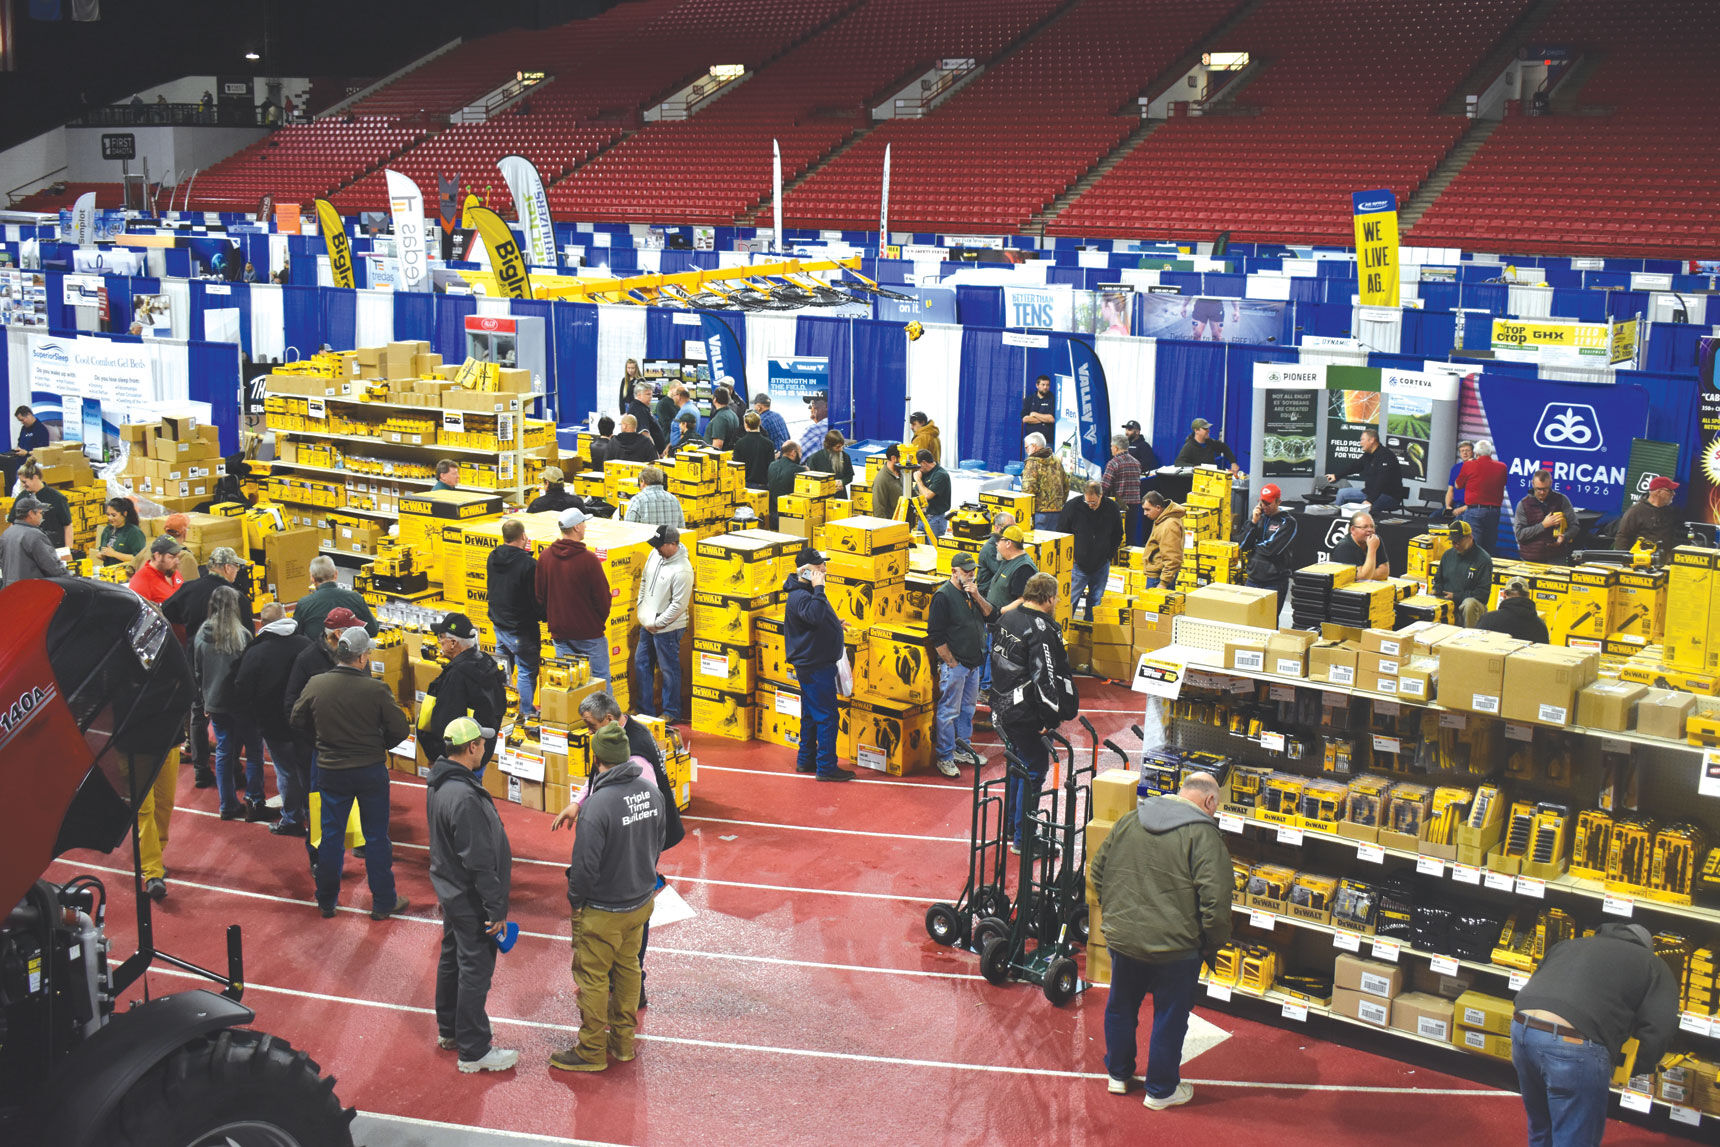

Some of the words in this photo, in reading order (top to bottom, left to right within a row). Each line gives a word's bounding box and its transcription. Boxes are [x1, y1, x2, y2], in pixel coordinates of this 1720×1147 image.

[111, 137, 133, 148] FIRST
[534, 191, 555, 264] ERTILIZERS
[1363, 221, 1382, 242] WE
[1365, 246, 1390, 268] LIVE
[372, 271, 394, 281] tredas
[1367, 273, 1385, 293] AG.
[1012, 293, 1034, 302] BETTER
[1034, 294, 1053, 303] THAN
[899, 303, 910, 313] on
[912, 301, 921, 313] it.
[1013, 303, 1053, 327] TENS
[1505, 326, 1526, 334] TOP
[1533, 331, 1564, 339] GHX
[1574, 328, 1599, 336] SEED
[1497, 333, 1527, 345] Crop
[33, 349, 69, 363] SuperiorSleep
[75, 354, 90, 364] Cool
[91, 356, 116, 367] Comfort
[771, 377, 806, 385] STRENGTH
[1283, 373, 1317, 382] PIONEER
[1399, 377, 1432, 388] CORTEVA
[250, 374, 267, 400] TH
[1078, 362, 1094, 422] VALLEY
[250, 404, 265, 413] Elk
[1509, 457, 1626, 486] AMERICAN
[1519, 477, 1560, 491] SIE
[1577, 484, 1610, 496] 1926
[400, 499, 433, 514] DEWALT
[460, 503, 488, 518] DEWALT
[465, 534, 499, 548] DEWALT
[698, 543, 726, 557] DEWALT
[753, 547, 773, 560] DEWALT
[782, 543, 803, 554] DEWALT
[611, 556, 631, 568] DEWALT
[1674, 553, 1710, 566] DEWALT
[1536, 579, 1568, 592] DEWALT
[1571, 572, 1606, 586] DEWALT
[1619, 574, 1654, 587] DEWALT
[695, 592, 722, 606] DEWALT
[610, 613, 631, 626] DEWALT
[757, 620, 778, 633] DEWALT
[870, 629, 893, 640] DEWALT
[694, 639, 722, 653] DEWALT
[610, 670, 630, 683] DEWALT
[1624, 669, 1650, 680] DEWALT
[693, 685, 720, 700] DEWALT
[0, 686, 47, 732] 140A
[851, 700, 873, 711] DEWALT
[623, 790, 651, 806] Triple
[628, 800, 650, 814] Time
[1223, 804, 1248, 815] DEWALT
[622, 808, 658, 826] Builders
[1264, 813, 1286, 823] DEWALT
[1304, 821, 1328, 831] DEWALT
[1252, 897, 1281, 910] DEWALT
[1293, 906, 1323, 920] DEWALT
[1337, 918, 1366, 933] DEWALT
